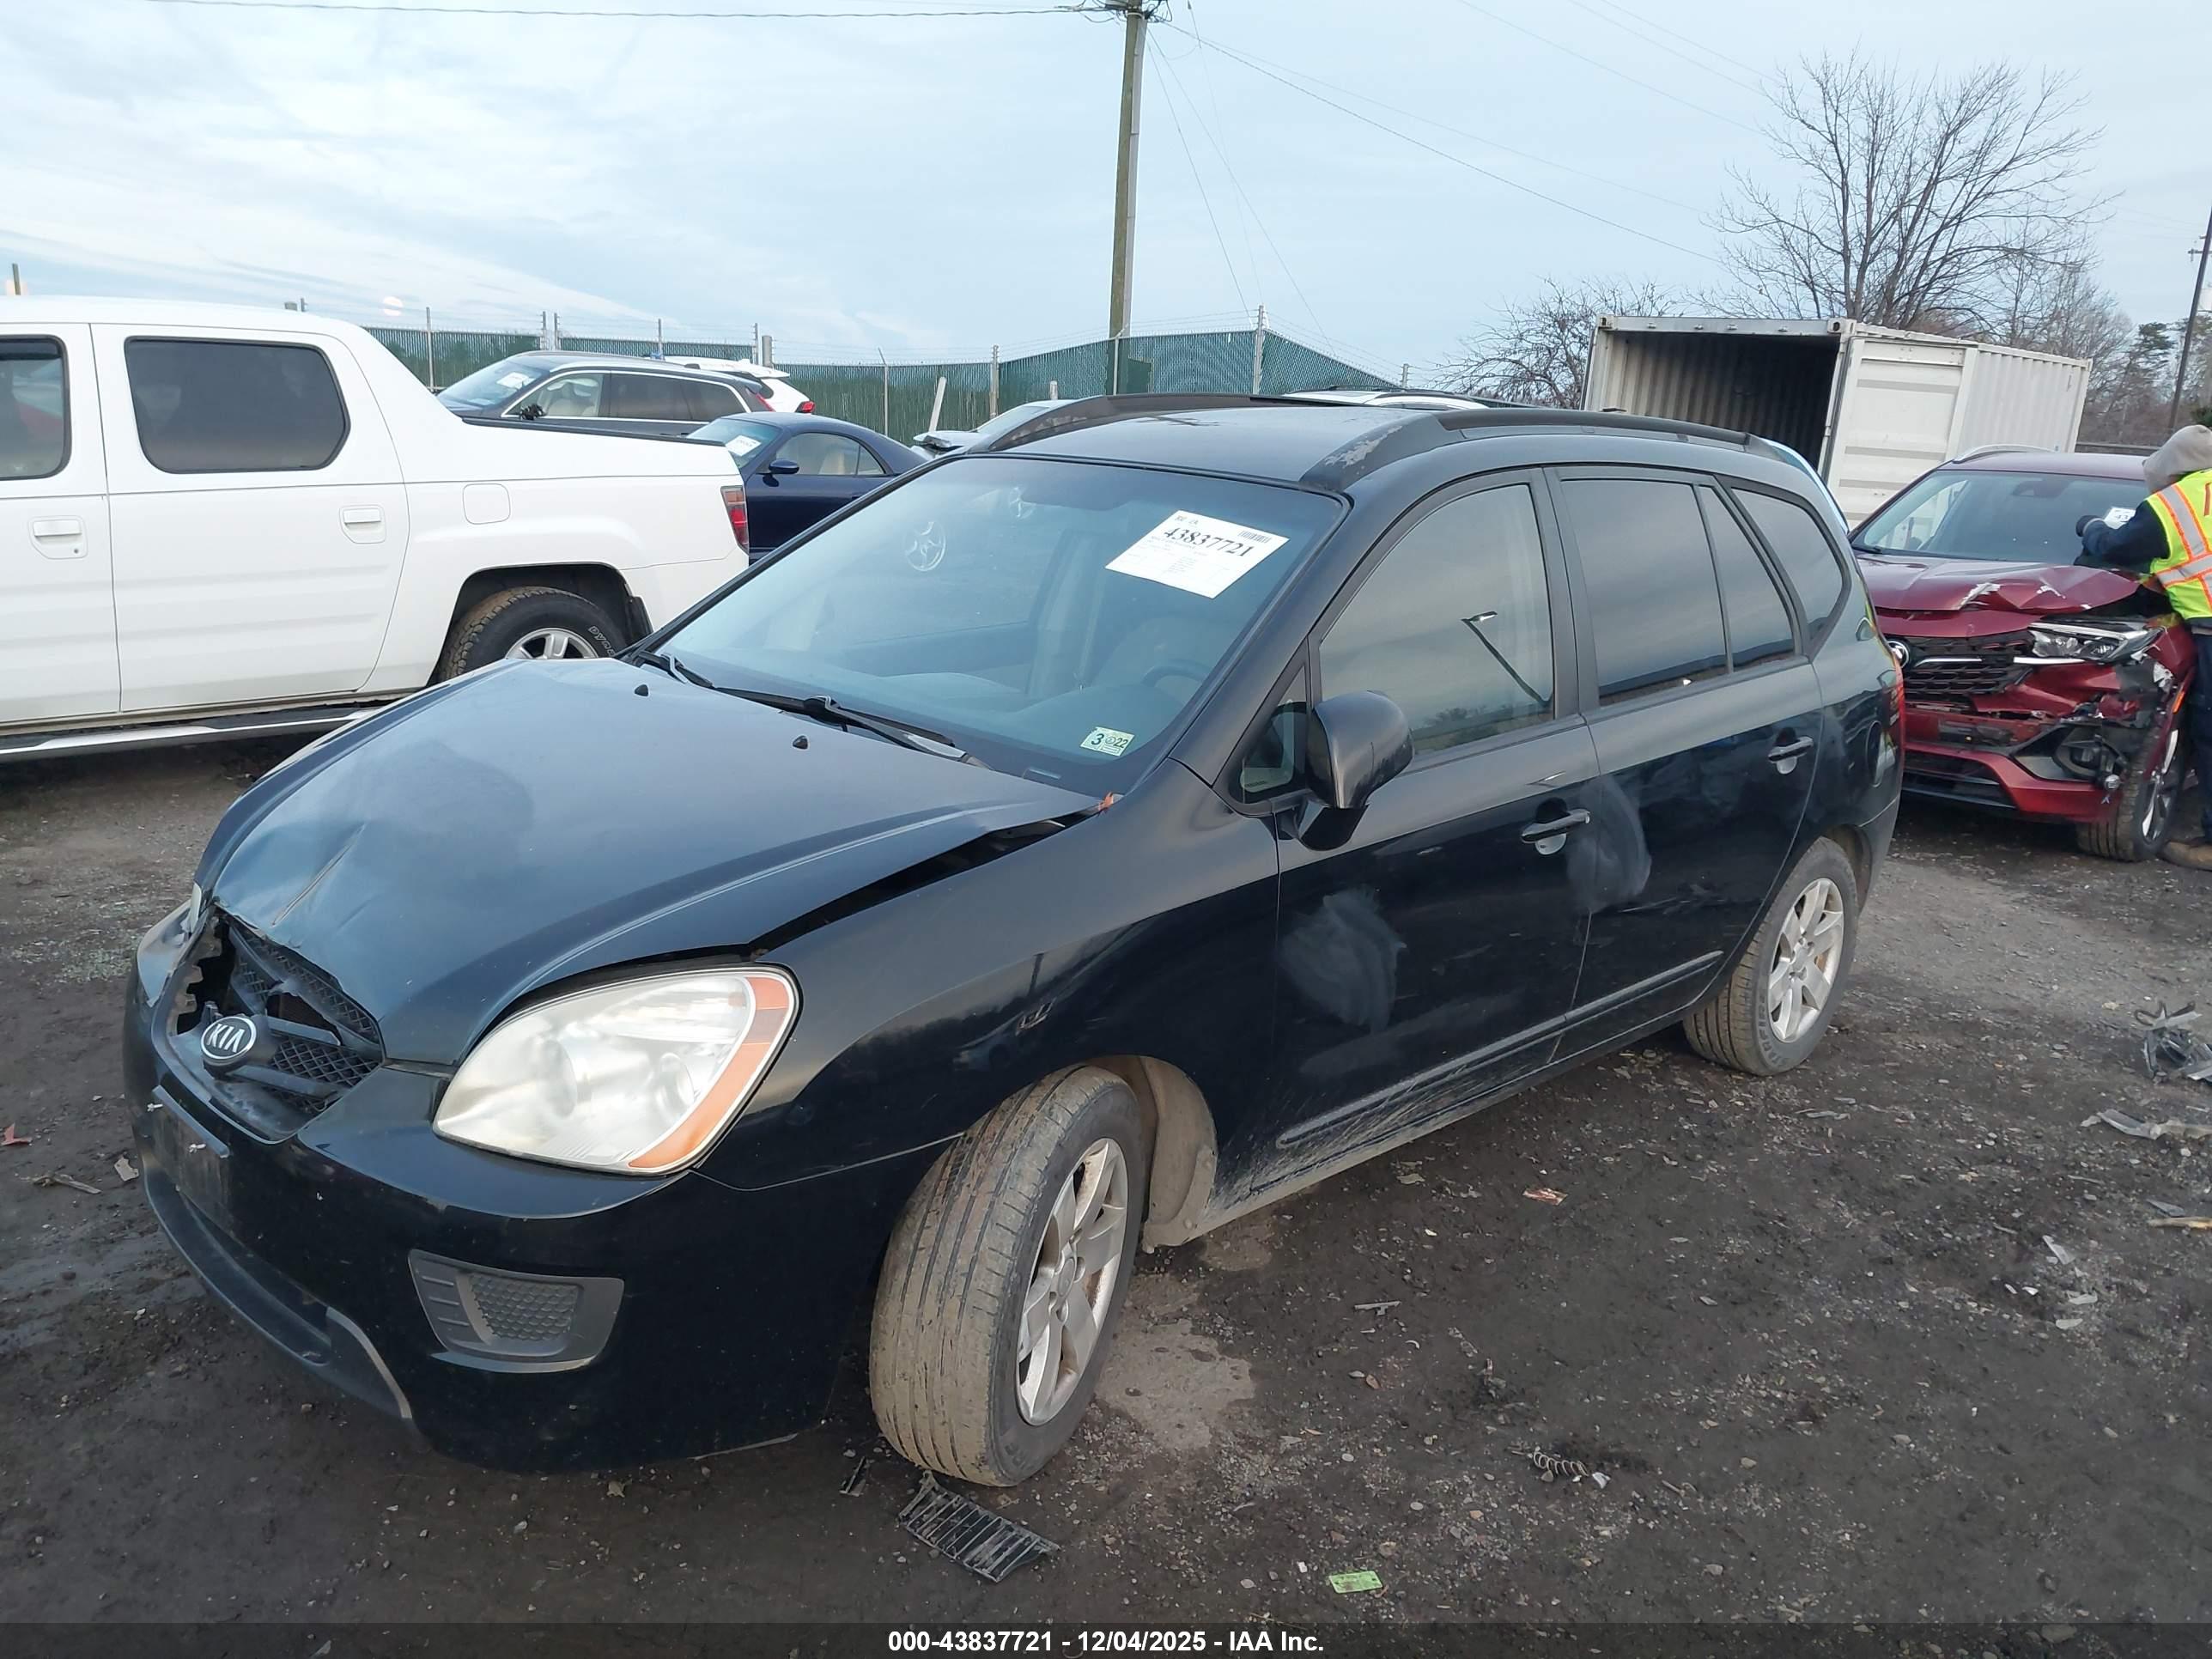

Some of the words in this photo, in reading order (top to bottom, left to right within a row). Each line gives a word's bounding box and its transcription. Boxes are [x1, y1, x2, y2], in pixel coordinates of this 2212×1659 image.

[1164, 526, 1255, 557] 43837721
[1091, 733, 1105, 745] 3
[206, 1023, 246, 1053] KIA
